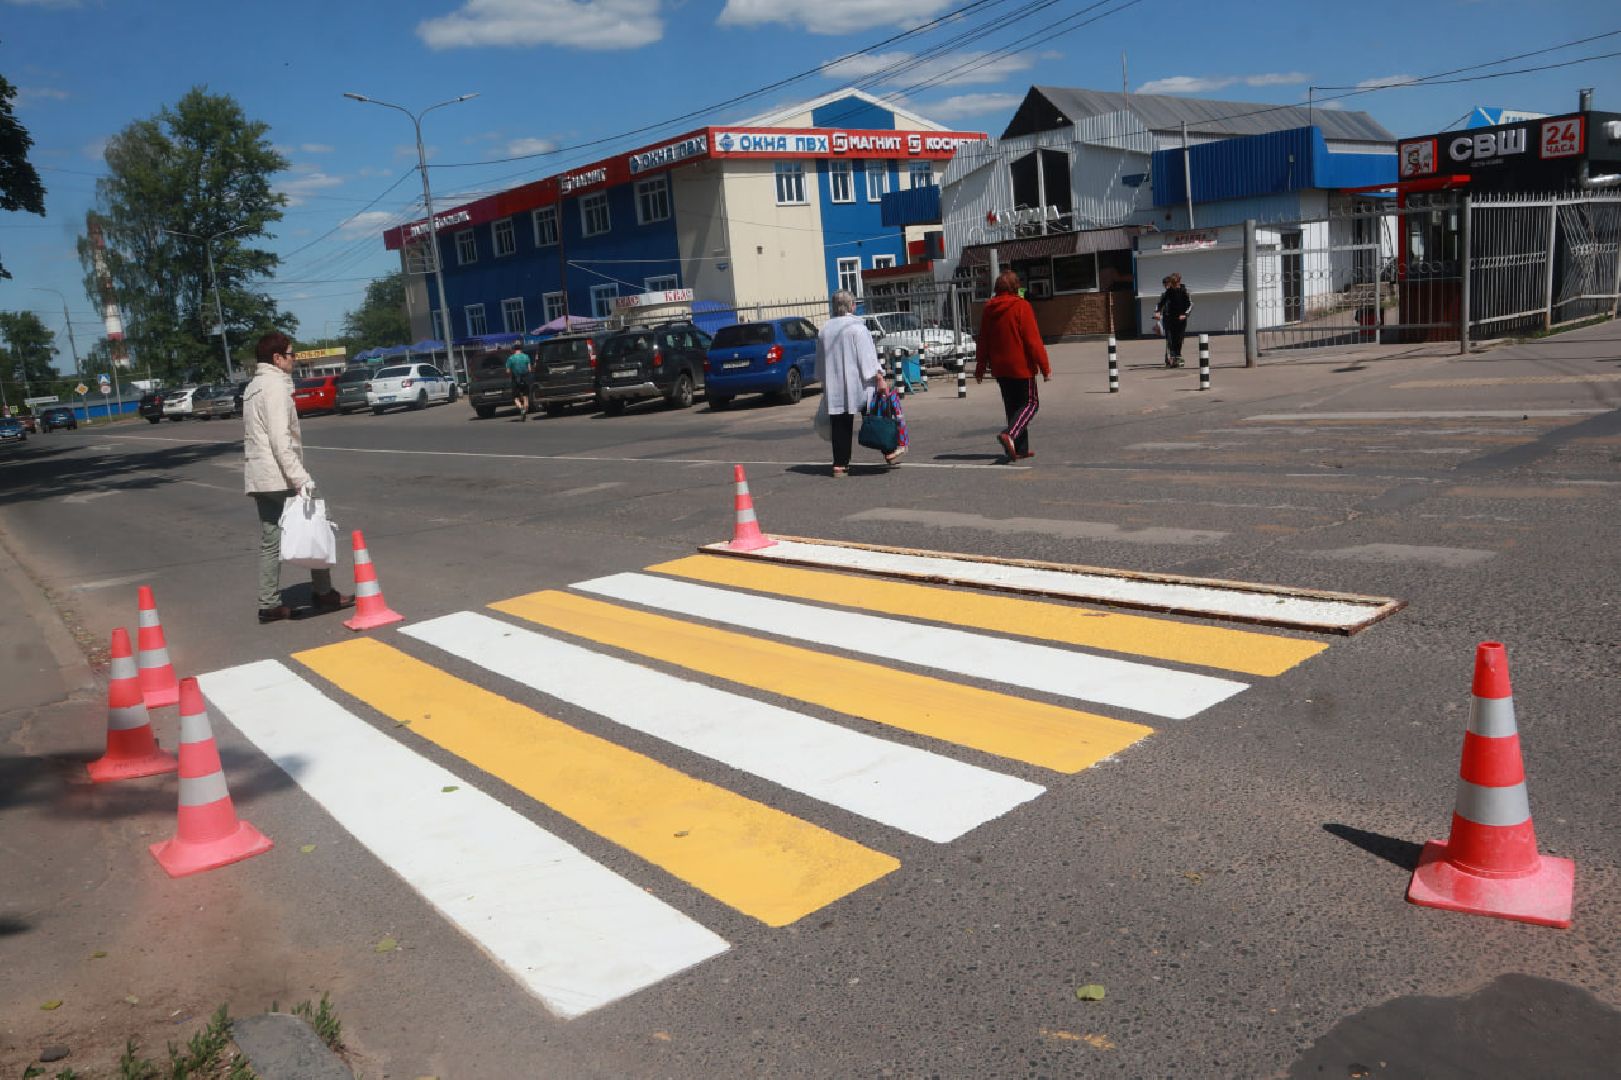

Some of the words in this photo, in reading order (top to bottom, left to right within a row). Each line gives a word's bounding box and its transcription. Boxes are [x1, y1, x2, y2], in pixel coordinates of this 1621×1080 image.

[1547, 123, 1576, 145] 24
[739, 135, 787, 151] ОКНА
[795, 136, 827, 152] ПВХ
[849, 136, 902, 150] МАГНИТ
[1450, 128, 1526, 161] СВШ
[1546, 143, 1575, 154] ЧАСА
